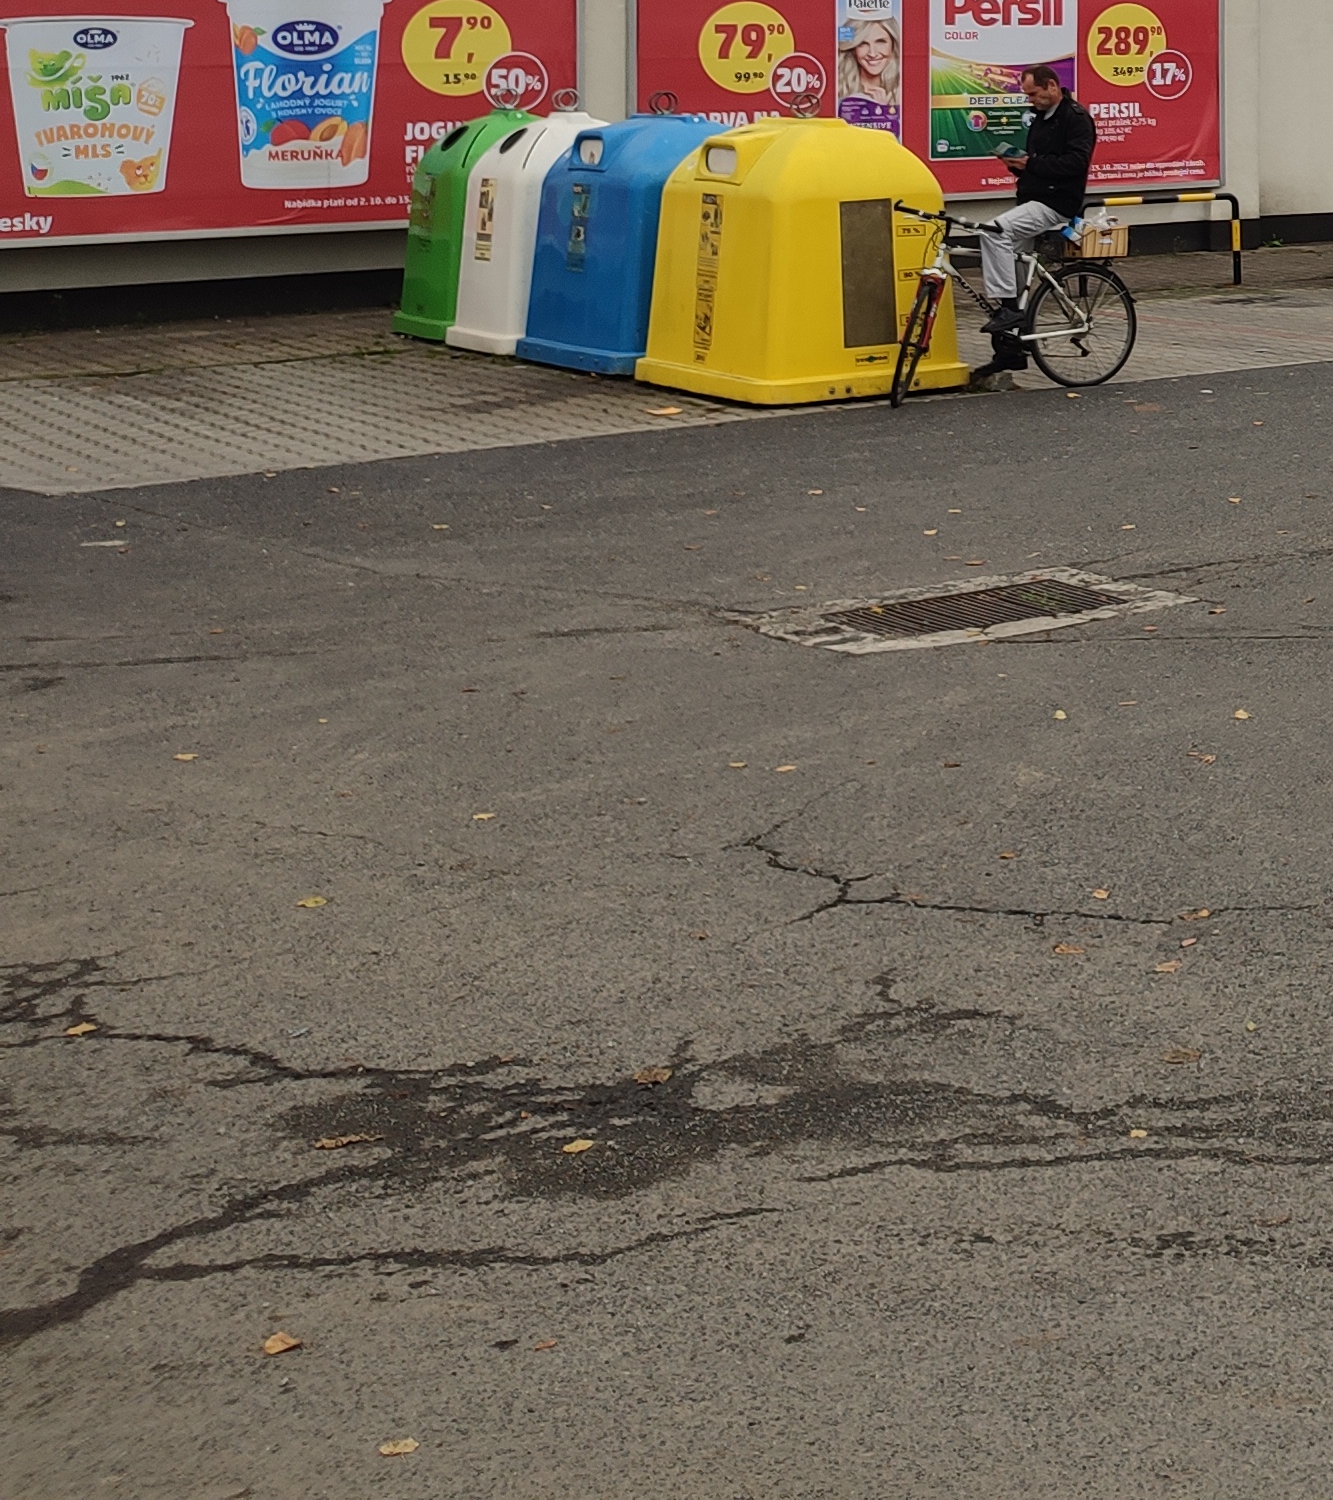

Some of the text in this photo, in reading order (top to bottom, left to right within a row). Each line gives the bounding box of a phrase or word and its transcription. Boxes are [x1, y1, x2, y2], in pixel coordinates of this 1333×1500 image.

[76, 32, 115, 44] OLMA
[277, 30, 334, 46] OLMA
[945, 31, 979, 41] COLOR
[240, 61, 370, 99] Florian
[490, 67, 541, 95] 50%
[776, 67, 821, 93] 20%
[1151, 62, 1186, 86] 17%
[41, 75, 132, 121] MÍŠA
[312, 97, 349, 108] JOGURT
[969, 96, 999, 105] DEEP
[315, 107, 342, 116] OVOCE
[1089, 102, 1143, 119] PERSIL
[1147, 117, 1157, 127] kg
[34, 123, 156, 148] TVAROHOVÝ
[75, 143, 113, 160] MLS
[268, 145, 344, 162] MERUŇKA
[284, 198, 322, 209] Nabídka
[346, 197, 358, 206] od
[386, 195, 397, 205] do
